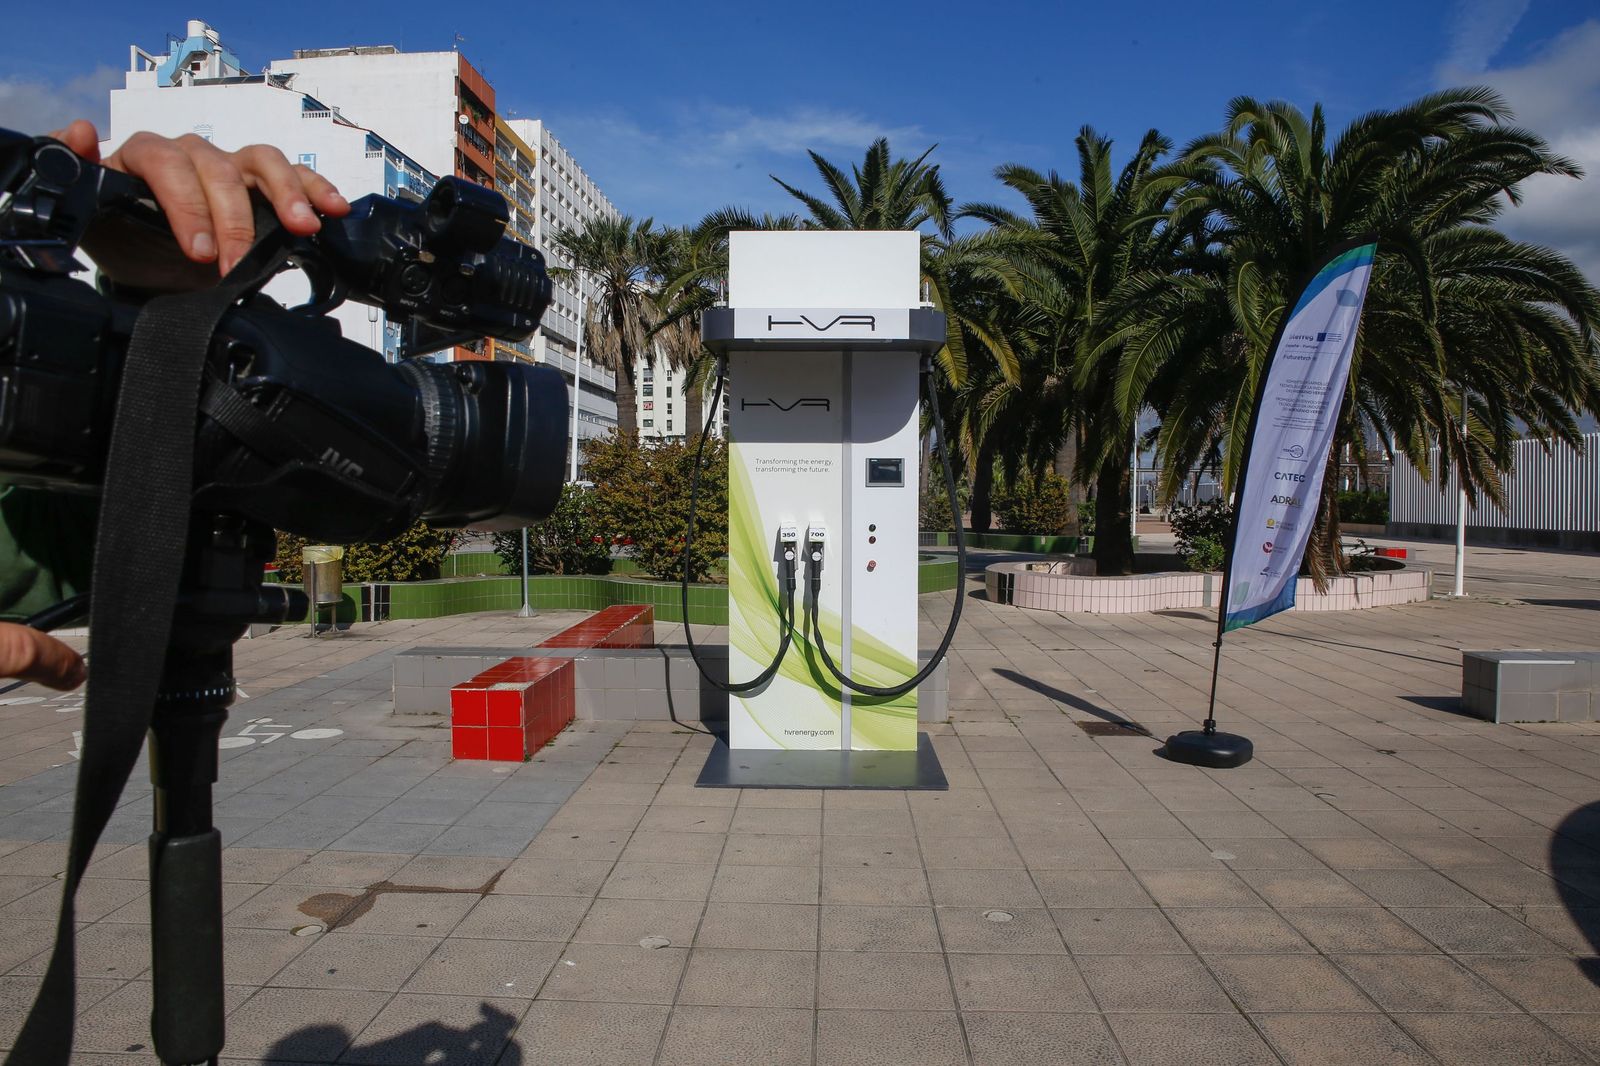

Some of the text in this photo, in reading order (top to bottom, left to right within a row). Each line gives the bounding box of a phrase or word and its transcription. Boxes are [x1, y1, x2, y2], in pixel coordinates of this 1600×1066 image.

[755, 458, 798, 466] Transforming
[1274, 471, 1306, 483] CATEC
[784, 729, 835, 737] hvrenergy.com
